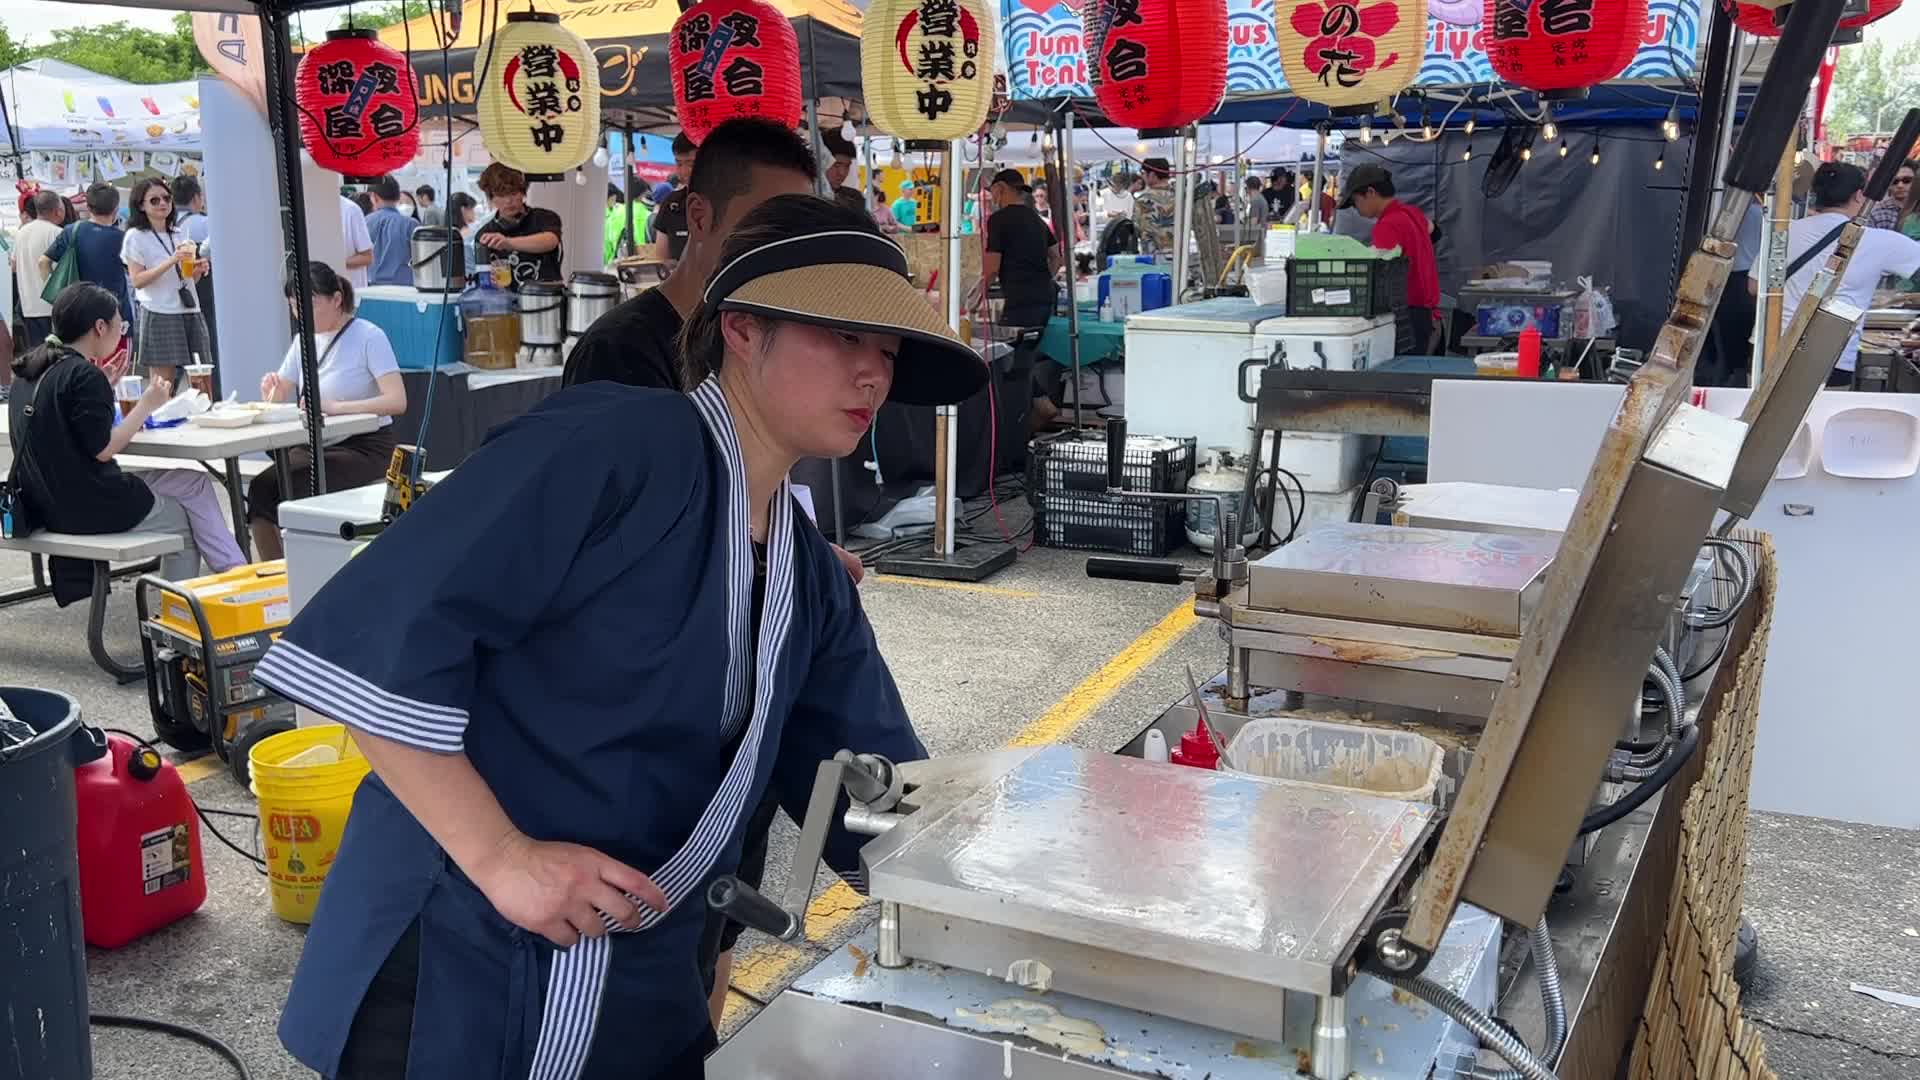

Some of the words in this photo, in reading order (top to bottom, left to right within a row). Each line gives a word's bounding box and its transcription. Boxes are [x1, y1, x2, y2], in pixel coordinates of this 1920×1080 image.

[1025, 31, 1081, 56] Jum
[1232, 23, 1267, 46] us
[418, 71, 474, 106] UNG
[1025, 59, 1087, 86] Tent
